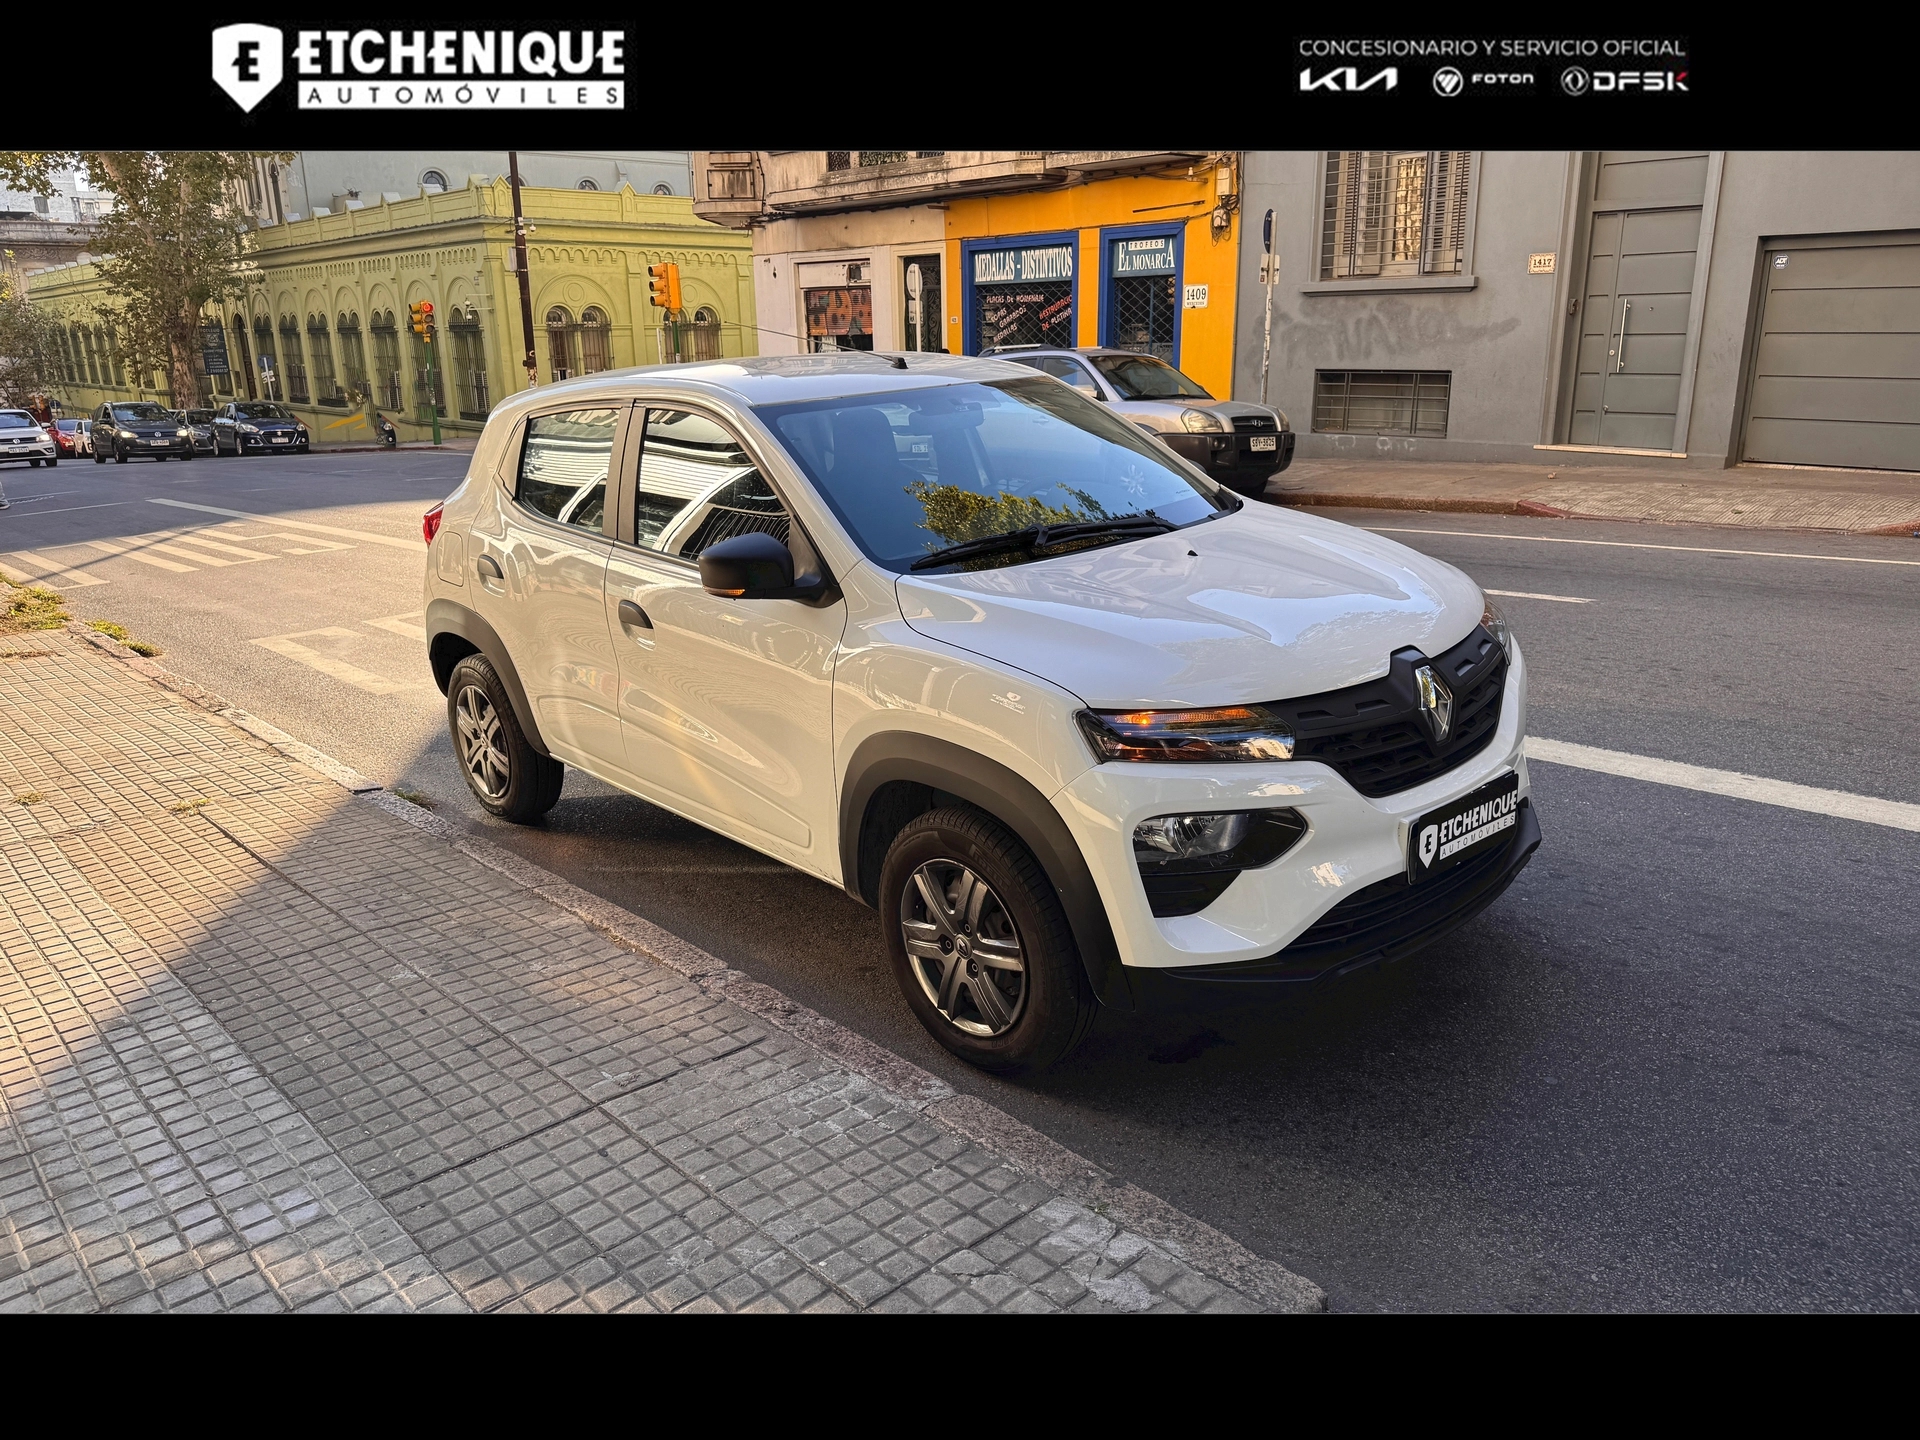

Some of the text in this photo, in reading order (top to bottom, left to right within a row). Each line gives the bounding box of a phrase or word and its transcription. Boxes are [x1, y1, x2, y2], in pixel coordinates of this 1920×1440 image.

[1129, 240, 1164, 249] TROFEOS
[975, 251, 1015, 282] MEDALLAS
[1021, 246, 1072, 279] DISTINTIVOS
[1533, 258, 1552, 266] 1417
[1186, 288, 1207, 301] 1409
[1439, 789, 1518, 844] ETCHENIQUE
